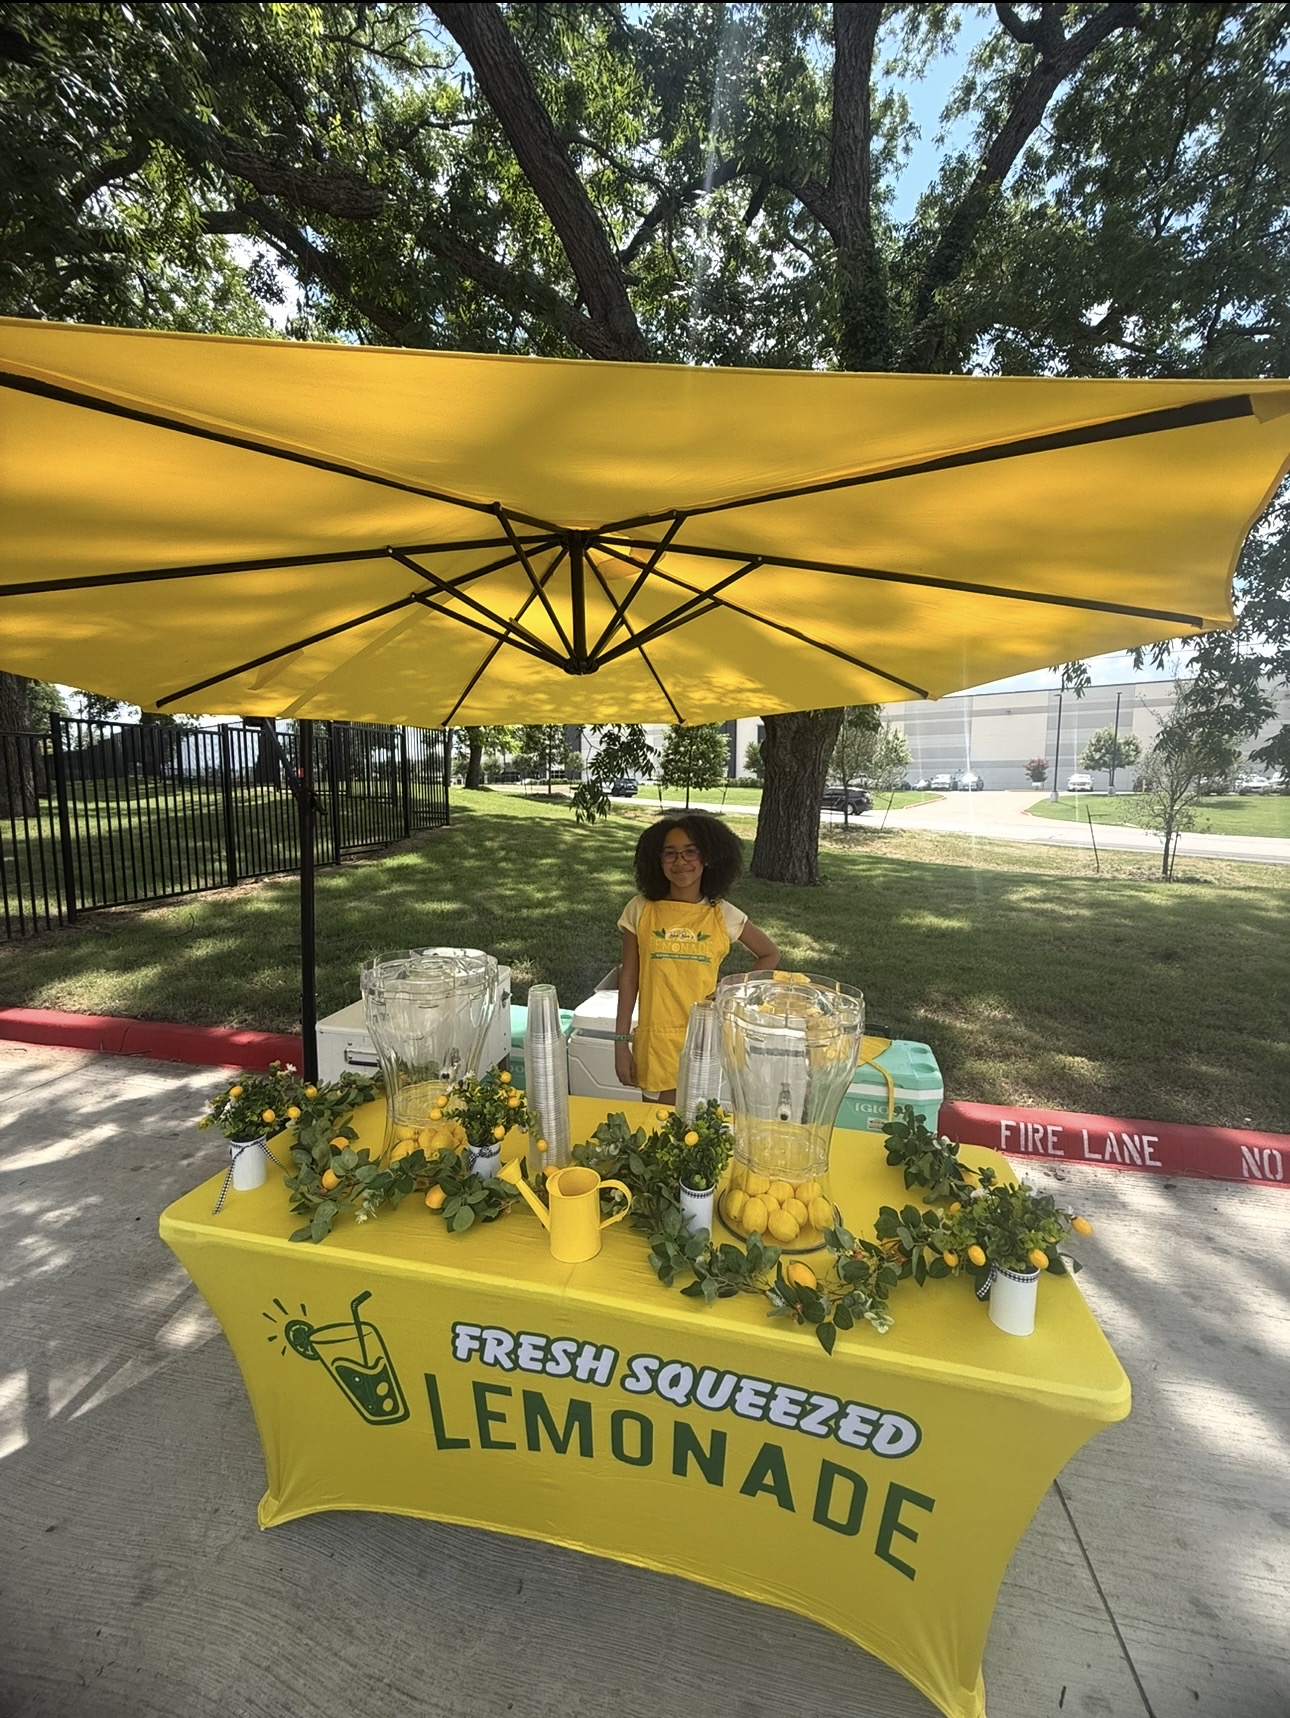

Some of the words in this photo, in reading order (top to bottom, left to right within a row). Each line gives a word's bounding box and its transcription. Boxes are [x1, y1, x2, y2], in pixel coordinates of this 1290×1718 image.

[1000, 1120, 1065, 1156] FIRE
[1082, 1128, 1163, 1167] LANE
[1240, 1145, 1284, 1181] NO
[451, 1321, 619, 1387] FRESH
[621, 1353, 923, 1459] SQUEEZED
[424, 1373, 936, 1582] LEMONADE
